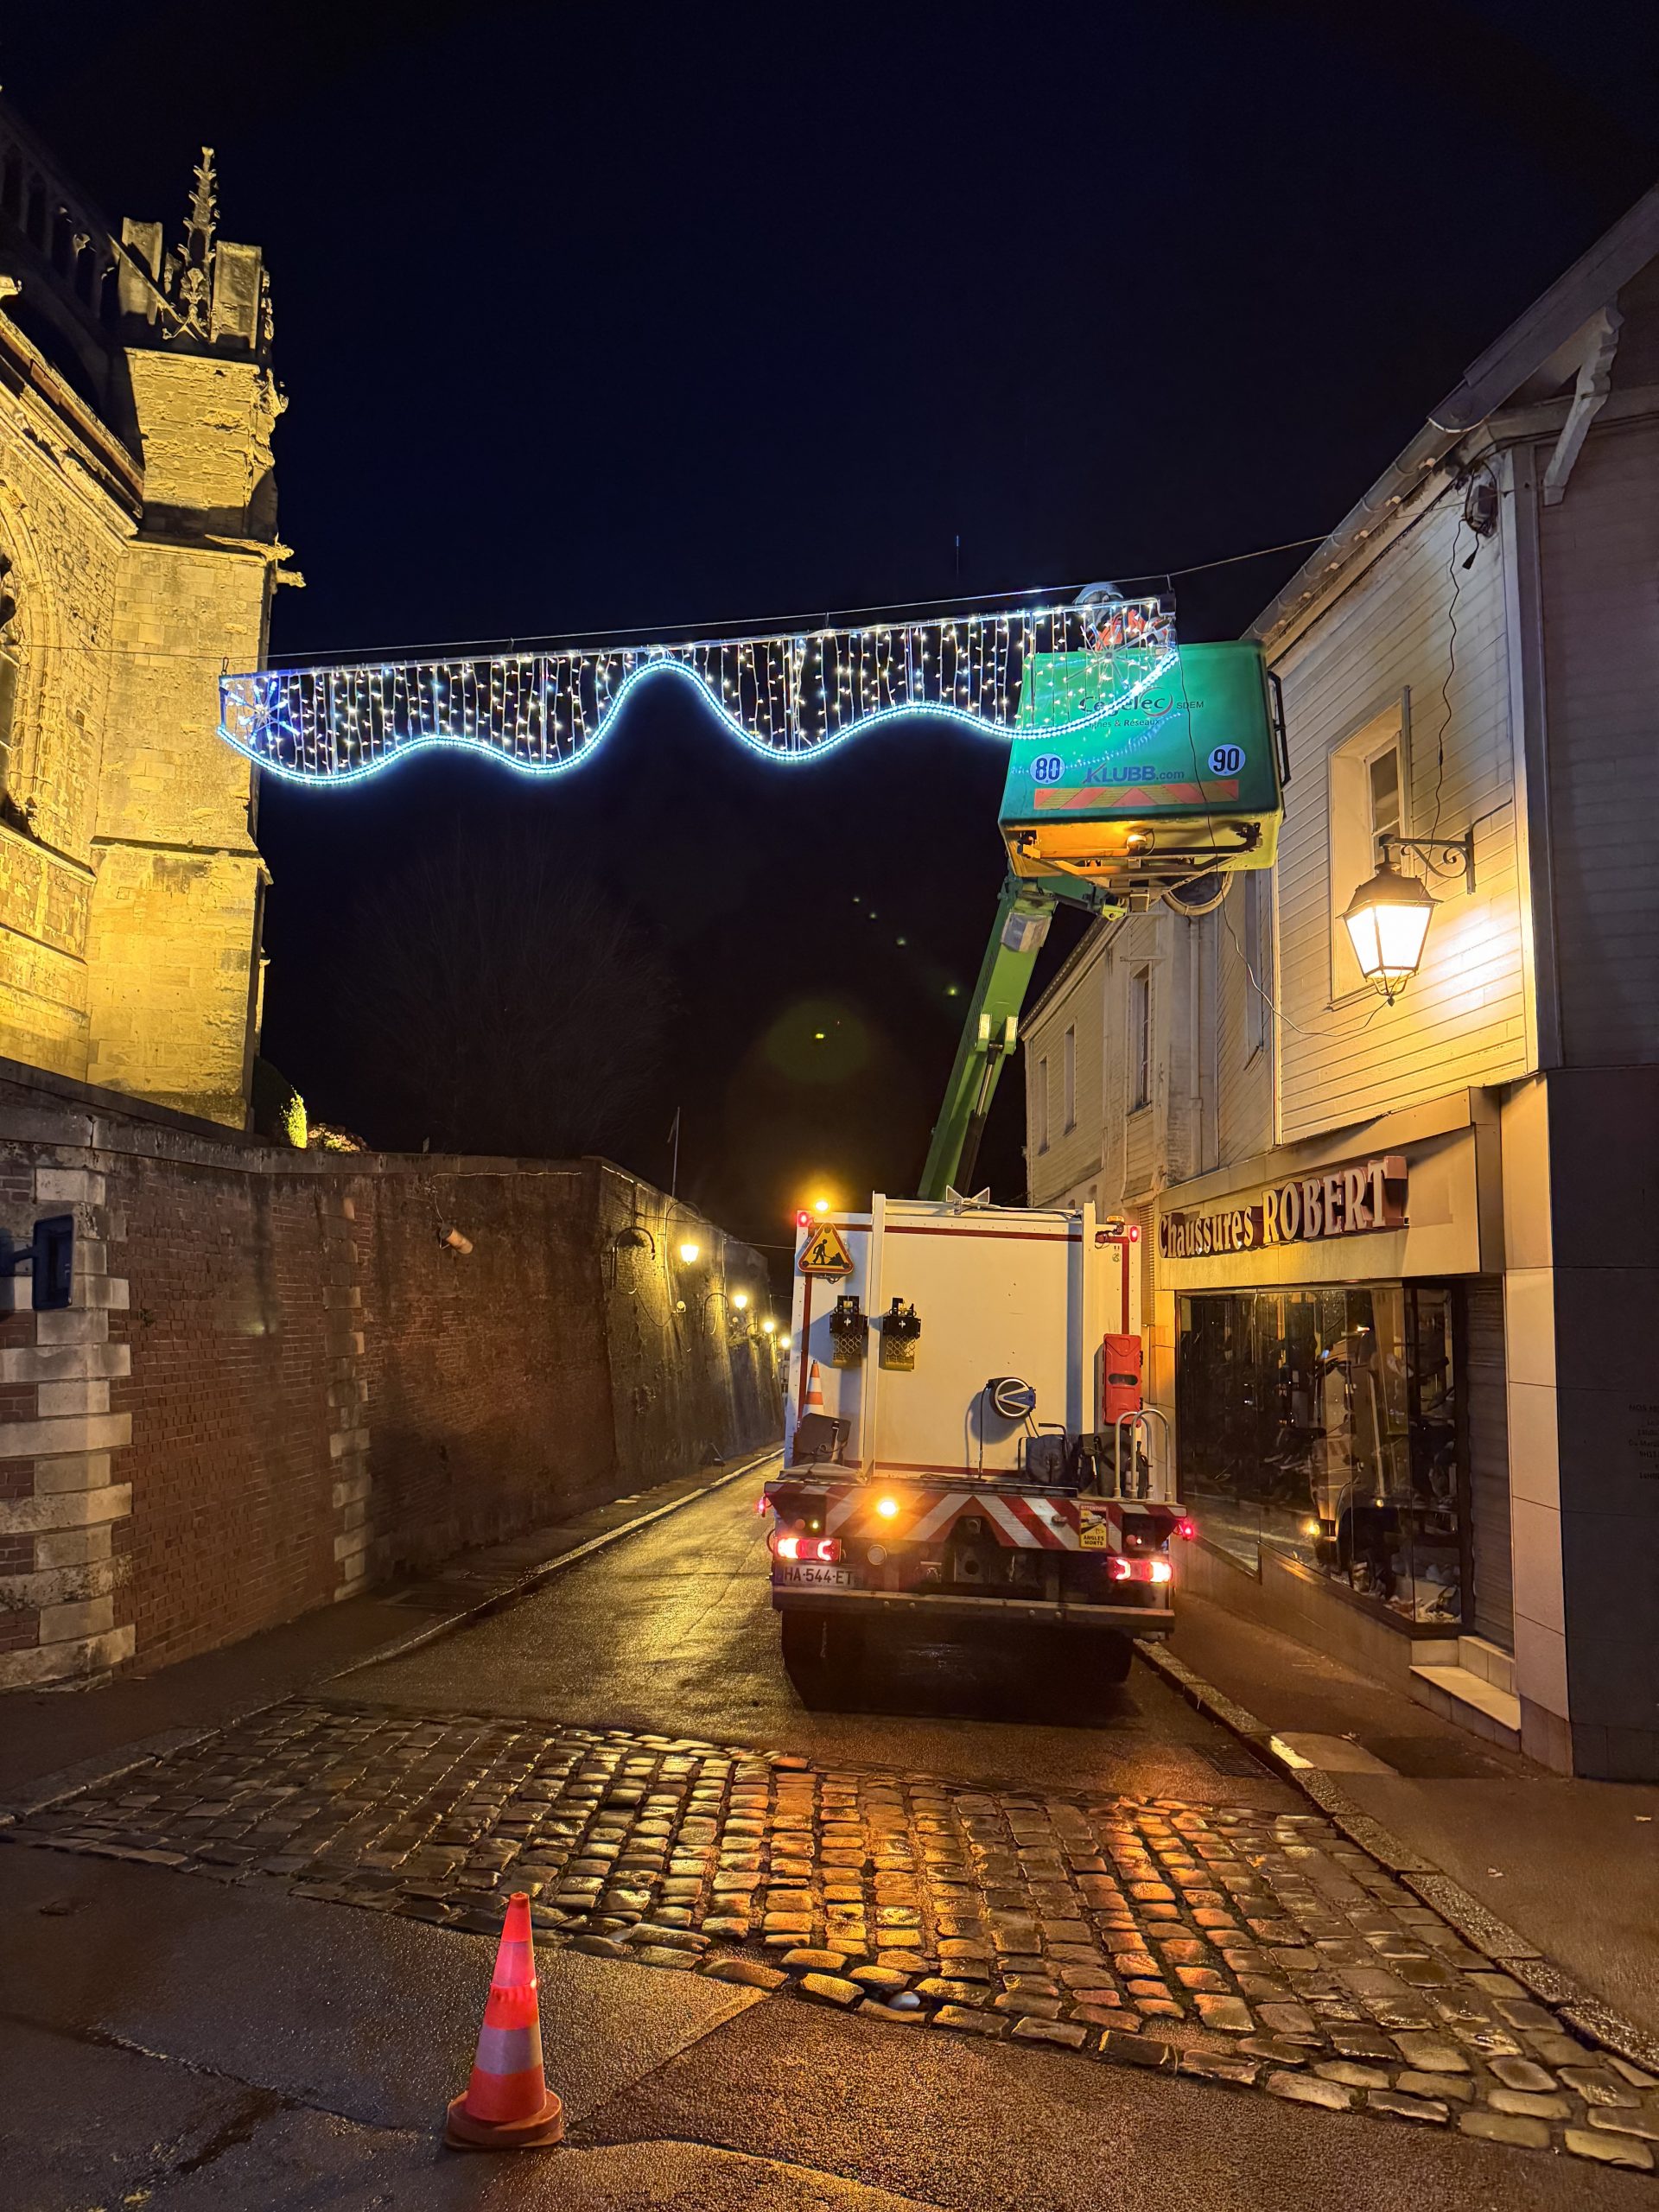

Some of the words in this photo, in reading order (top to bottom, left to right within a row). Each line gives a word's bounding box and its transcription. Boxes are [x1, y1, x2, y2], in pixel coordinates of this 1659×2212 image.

[1124, 718, 1160, 727] Réseaux
[1035, 757, 1061, 781] 80
[1212, 747, 1240, 772] 90
[1082, 761, 1185, 784] KLUBB.com
[1159, 1205, 1254, 1258] Chaussures
[1262, 1160, 1388, 1245] ROBERT
